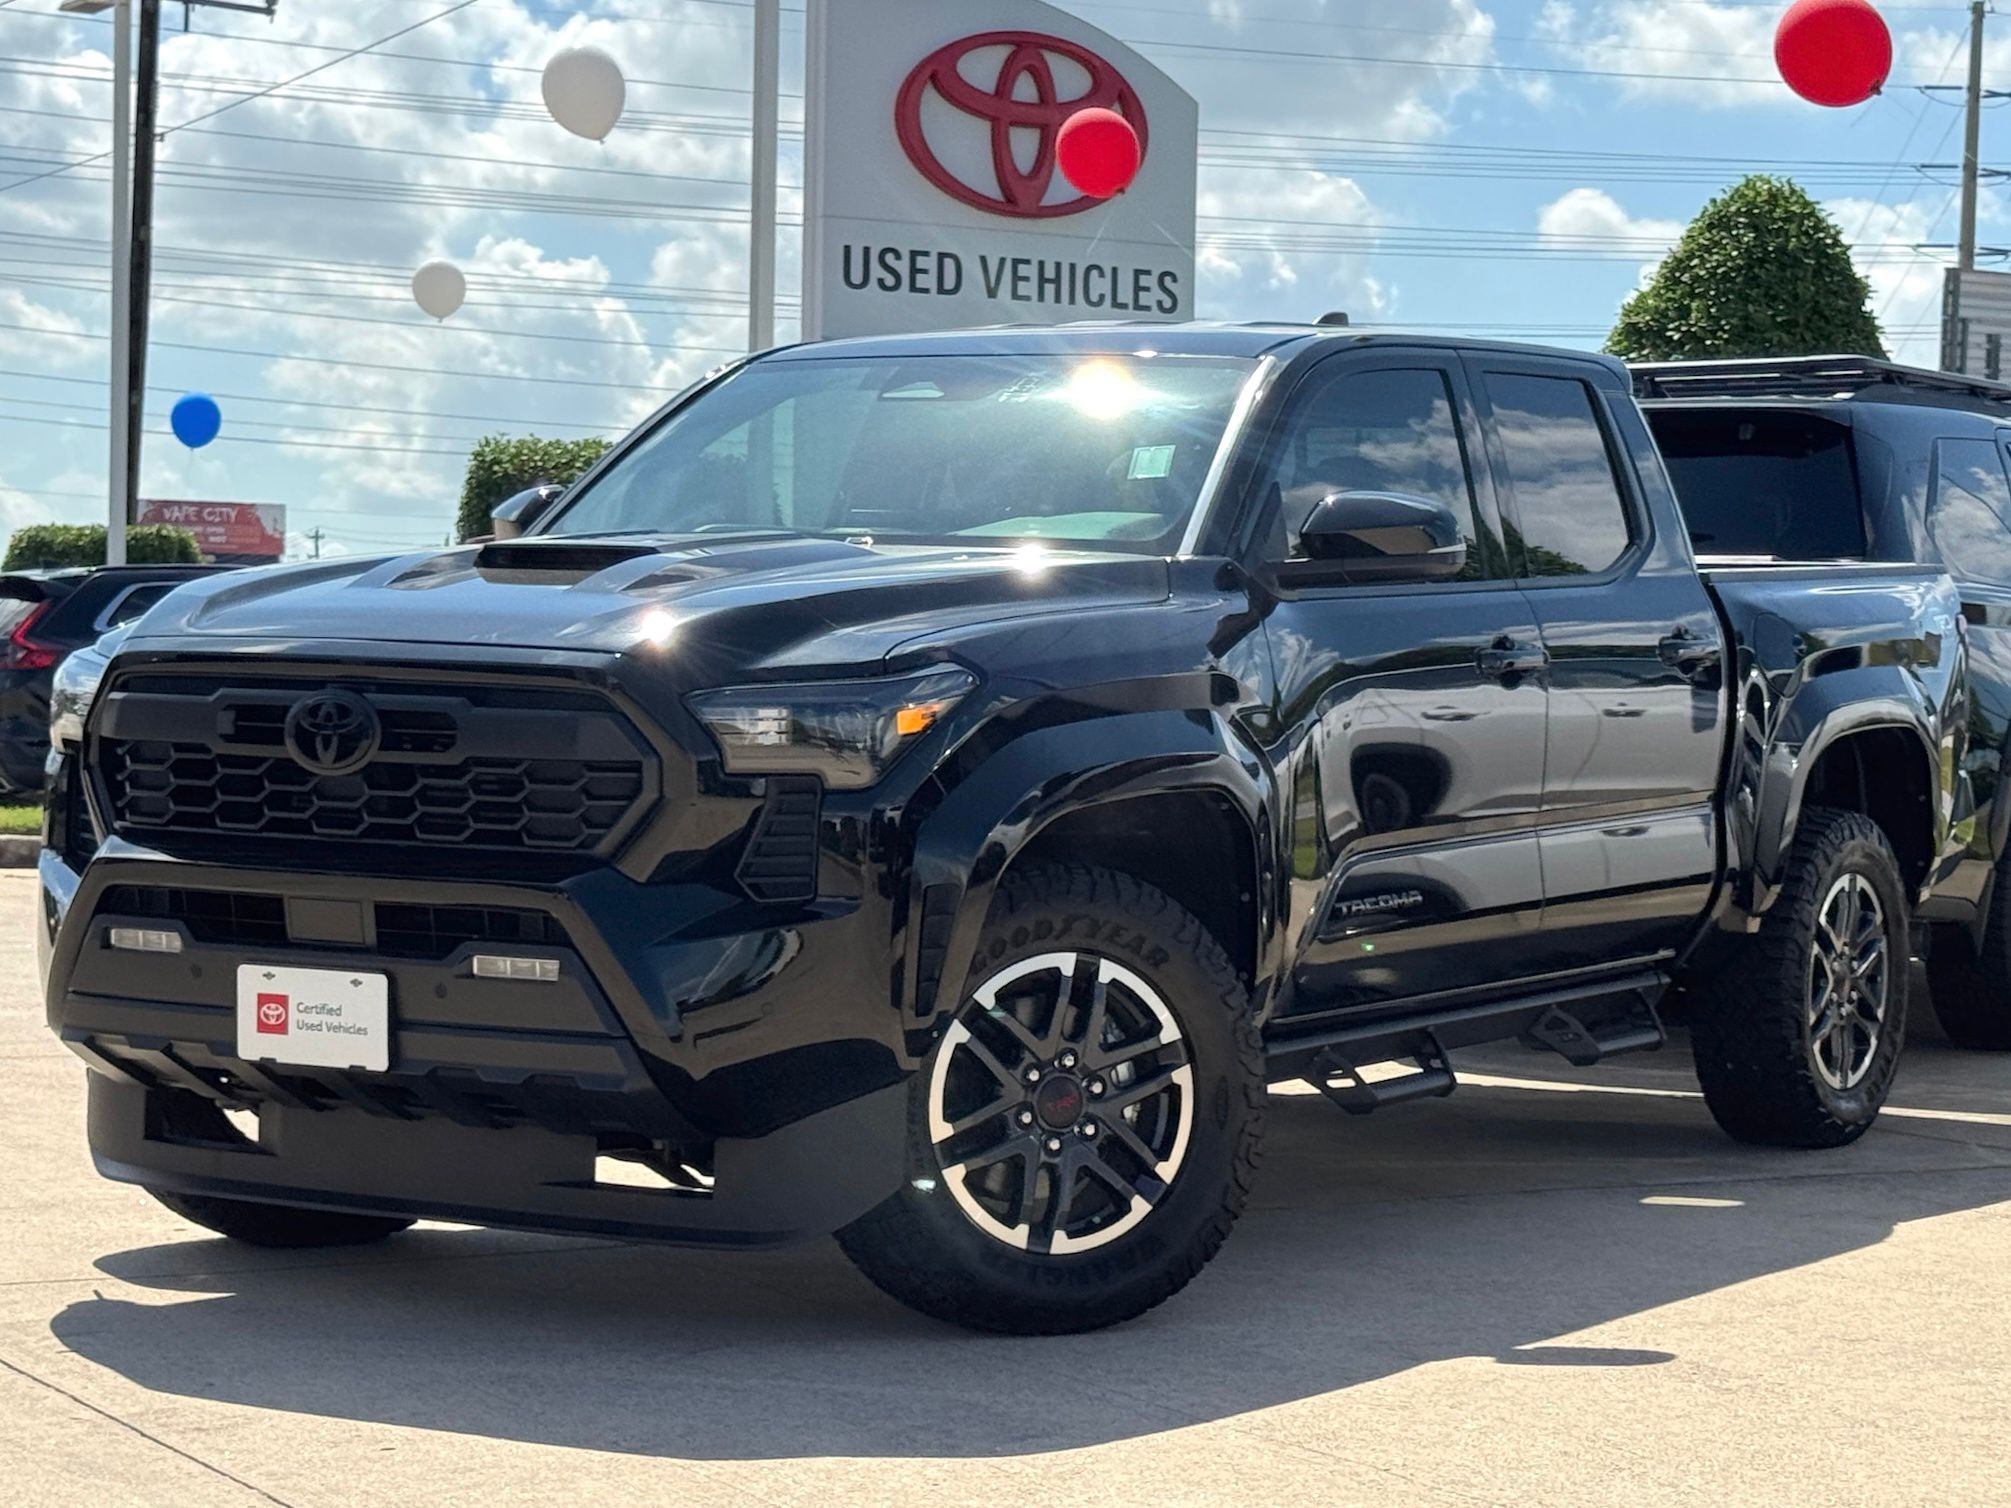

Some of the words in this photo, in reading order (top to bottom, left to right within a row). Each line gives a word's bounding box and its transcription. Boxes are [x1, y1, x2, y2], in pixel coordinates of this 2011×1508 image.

[843, 245, 963, 295] USED
[979, 255, 1179, 314] VEHICLES
[162, 505, 199, 522] VAPE
[203, 507, 238, 522] CITY
[1335, 890, 1423, 913] TACOMA
[296, 1002, 342, 1017] Certified
[296, 1020, 322, 1032] Used
[325, 1021, 368, 1035] Vehicles
